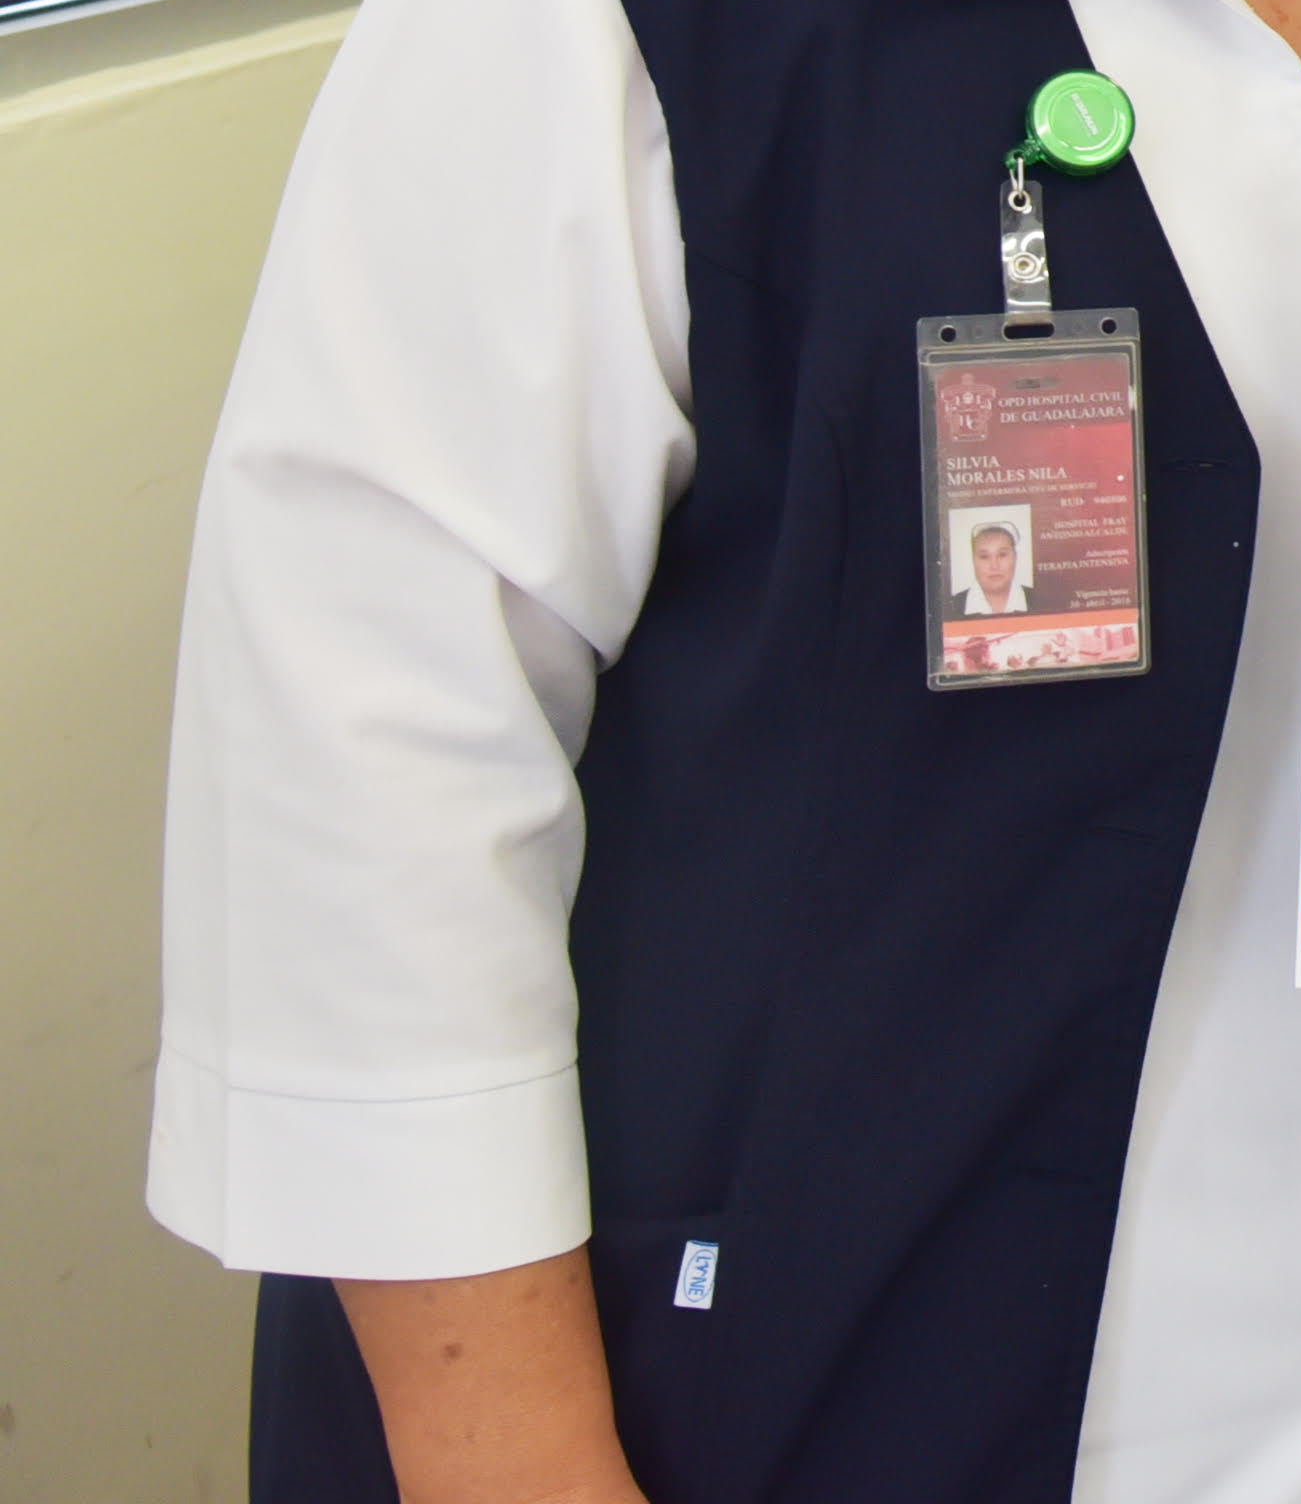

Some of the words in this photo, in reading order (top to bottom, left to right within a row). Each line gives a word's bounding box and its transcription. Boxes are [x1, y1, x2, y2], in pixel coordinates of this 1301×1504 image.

[998, 396, 1025, 408] OPD
[1027, 394, 1086, 406] HOSPITAL
[1090, 391, 1120, 402] CIVIL
[1000, 412, 1018, 423] DE
[1021, 406, 1124, 422] GUADALAJARA
[946, 456, 1000, 470] SILVIA
[947, 469, 1025, 486] MORALES
[1028, 467, 1067, 481] NILA
